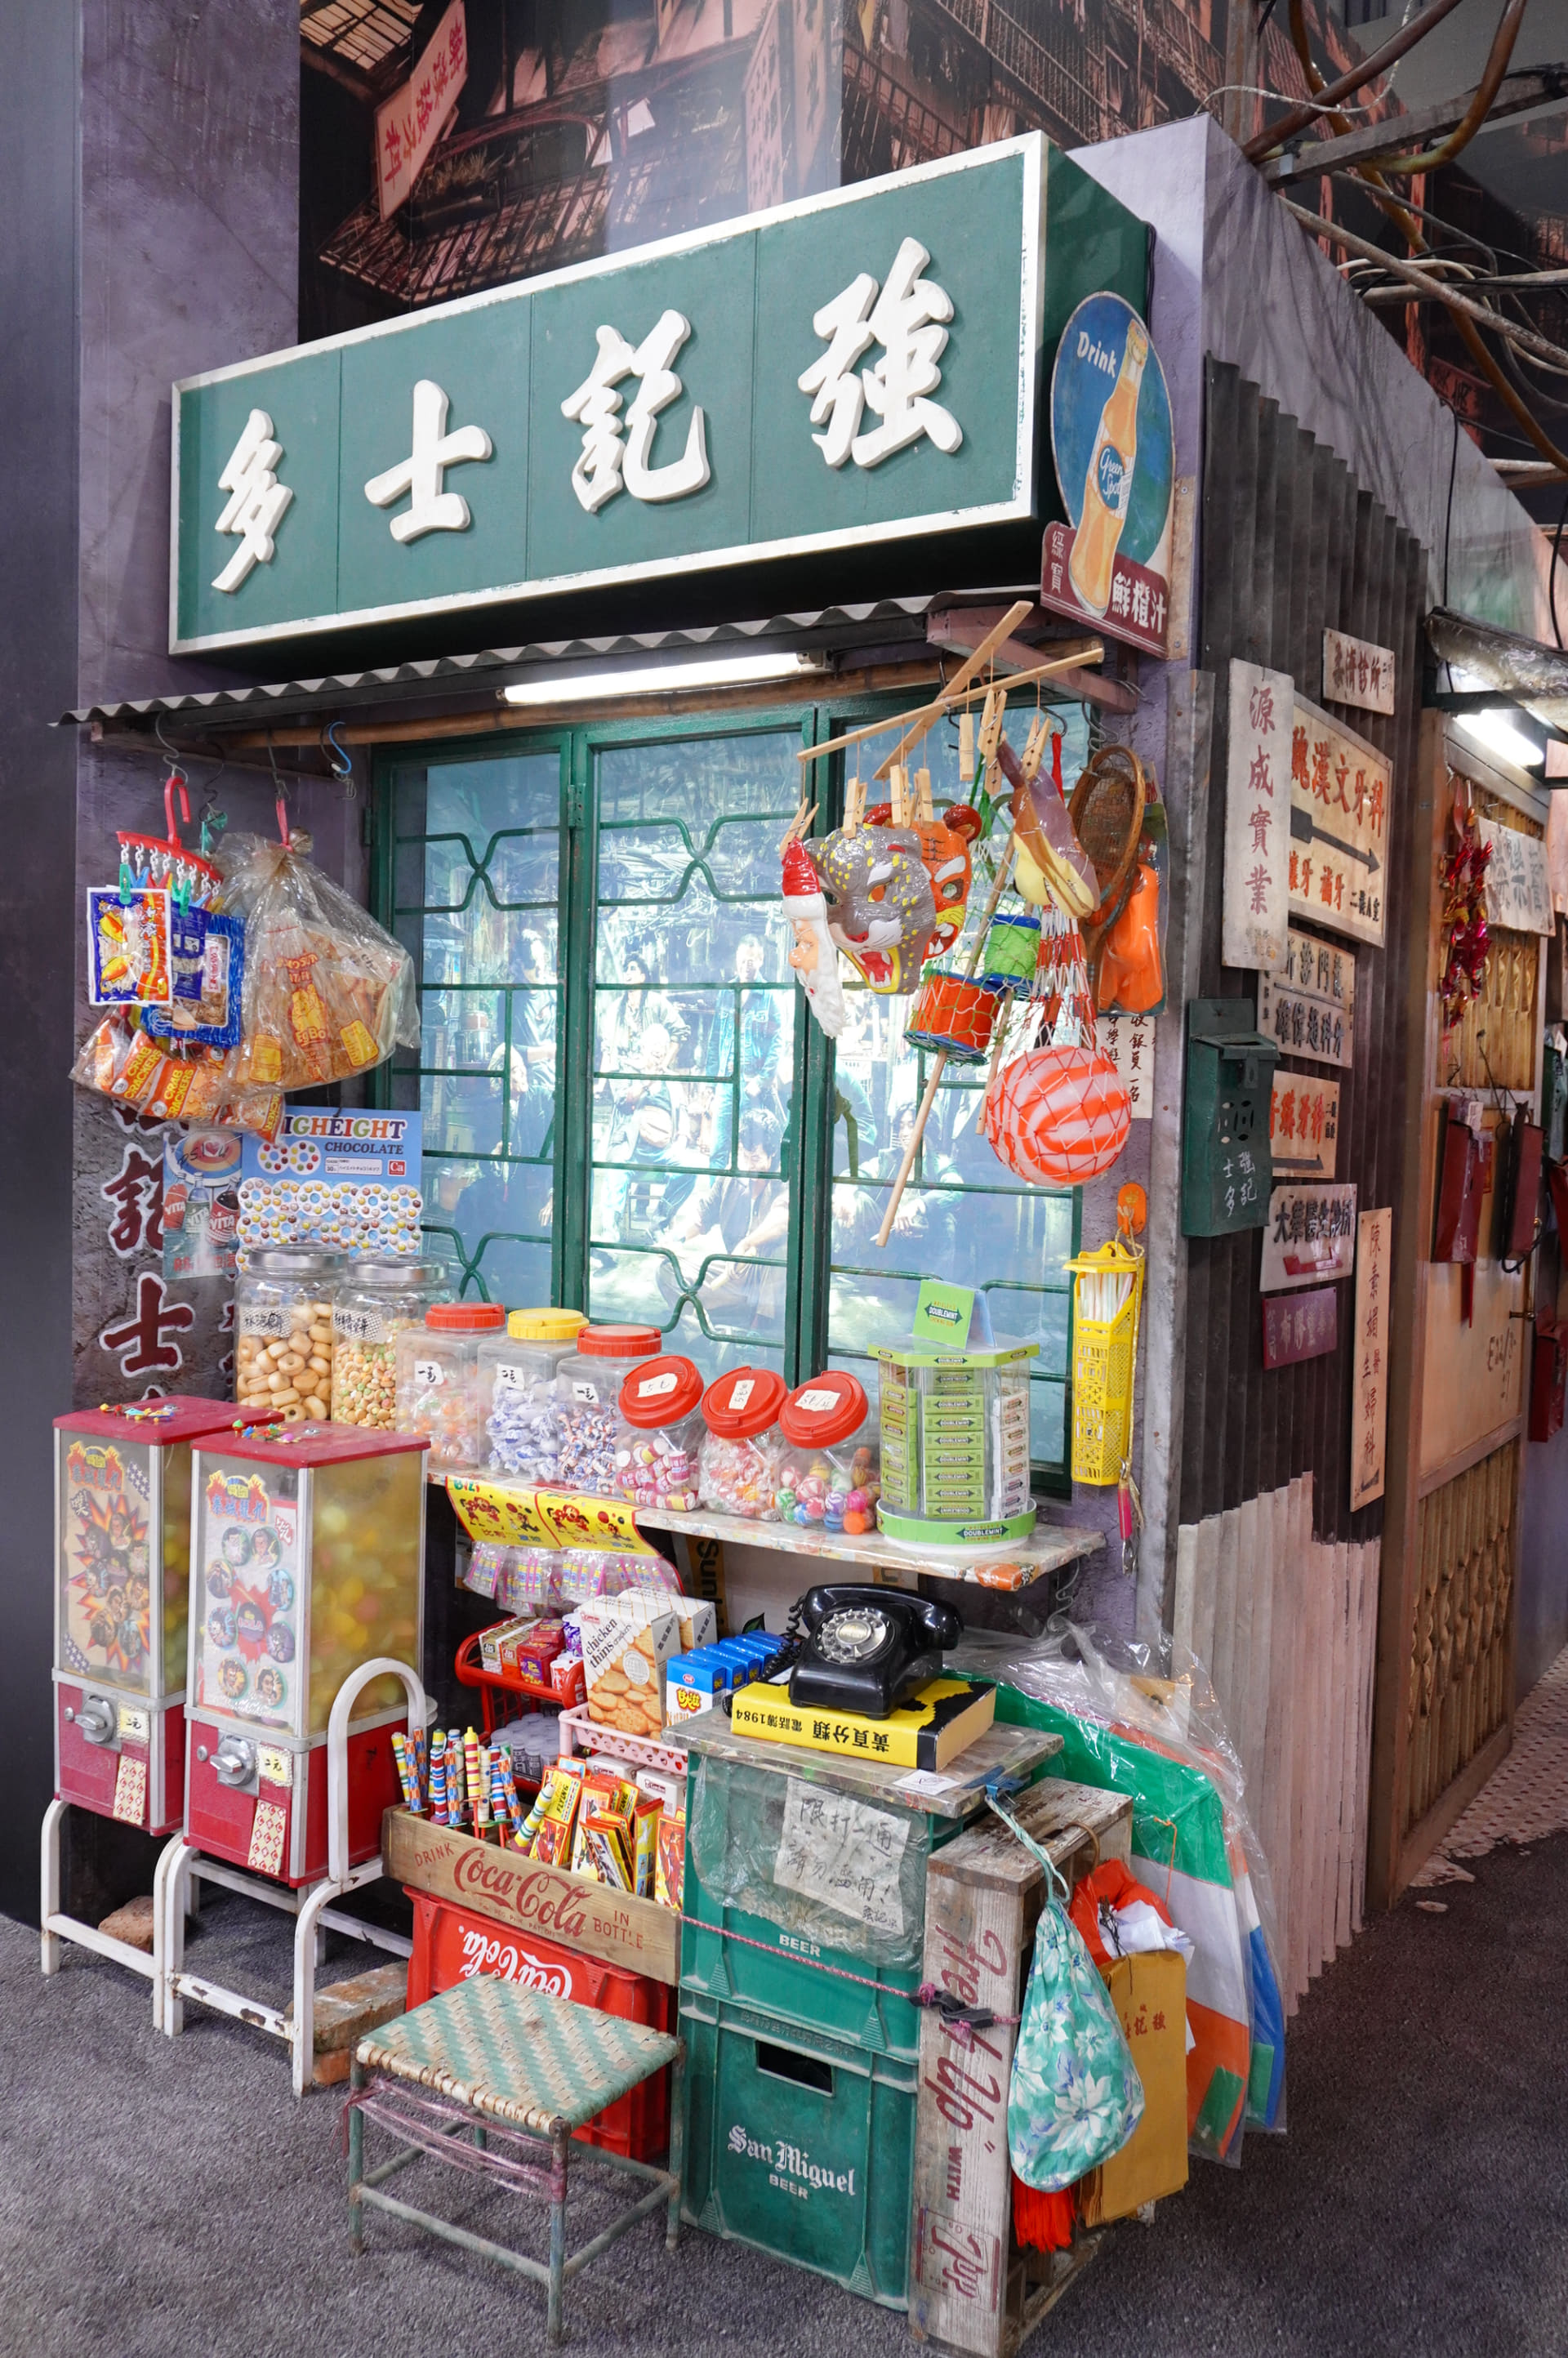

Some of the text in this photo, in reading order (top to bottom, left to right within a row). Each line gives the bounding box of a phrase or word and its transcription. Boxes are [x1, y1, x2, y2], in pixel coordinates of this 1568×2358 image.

[1076, 332, 1116, 378] Drink
[1099, 448, 1124, 480] Green
[1051, 531, 1065, 594] 綠寶
[1112, 571, 1168, 634] 鮮橙汁
[1244, 684, 1276, 916] 源成實業
[124, 1046, 163, 1099] CRAB CRACKERS
[1129, 1016, 1148, 1103] 收銀員一名
[163, 1068, 194, 1119] CRAB CRACKERS
[280, 1116, 407, 1139] IGHEIGHT
[324, 1143, 404, 1155] CHOCOLATE
[165, 1201, 186, 1215] VITA
[209, 1215, 235, 1230] VITA
[929, 1306, 958, 1320] DOUBLEMINT
[963, 1527, 1004, 1538] DOUBLEMINT
[586, 1618, 618, 1656] chicken
[590, 1642, 615, 1669] thins
[613, 1624, 633, 1647] crackers
[736, 1708, 890, 1753] 黃頁分類 電話簿1984
[556, 1785, 569, 1814] FLYING
[800, 1797, 892, 1858] 限打一通
[414, 1843, 455, 1868] DRINK
[453, 1847, 593, 1938] Coca-Cola
[614, 1910, 630, 1926] IN
[778, 1933, 822, 1958] BEER
[727, 2124, 857, 2196] San Miguel
[946, 2146, 962, 2203] WITH
[768, 2173, 808, 2200] BEER
